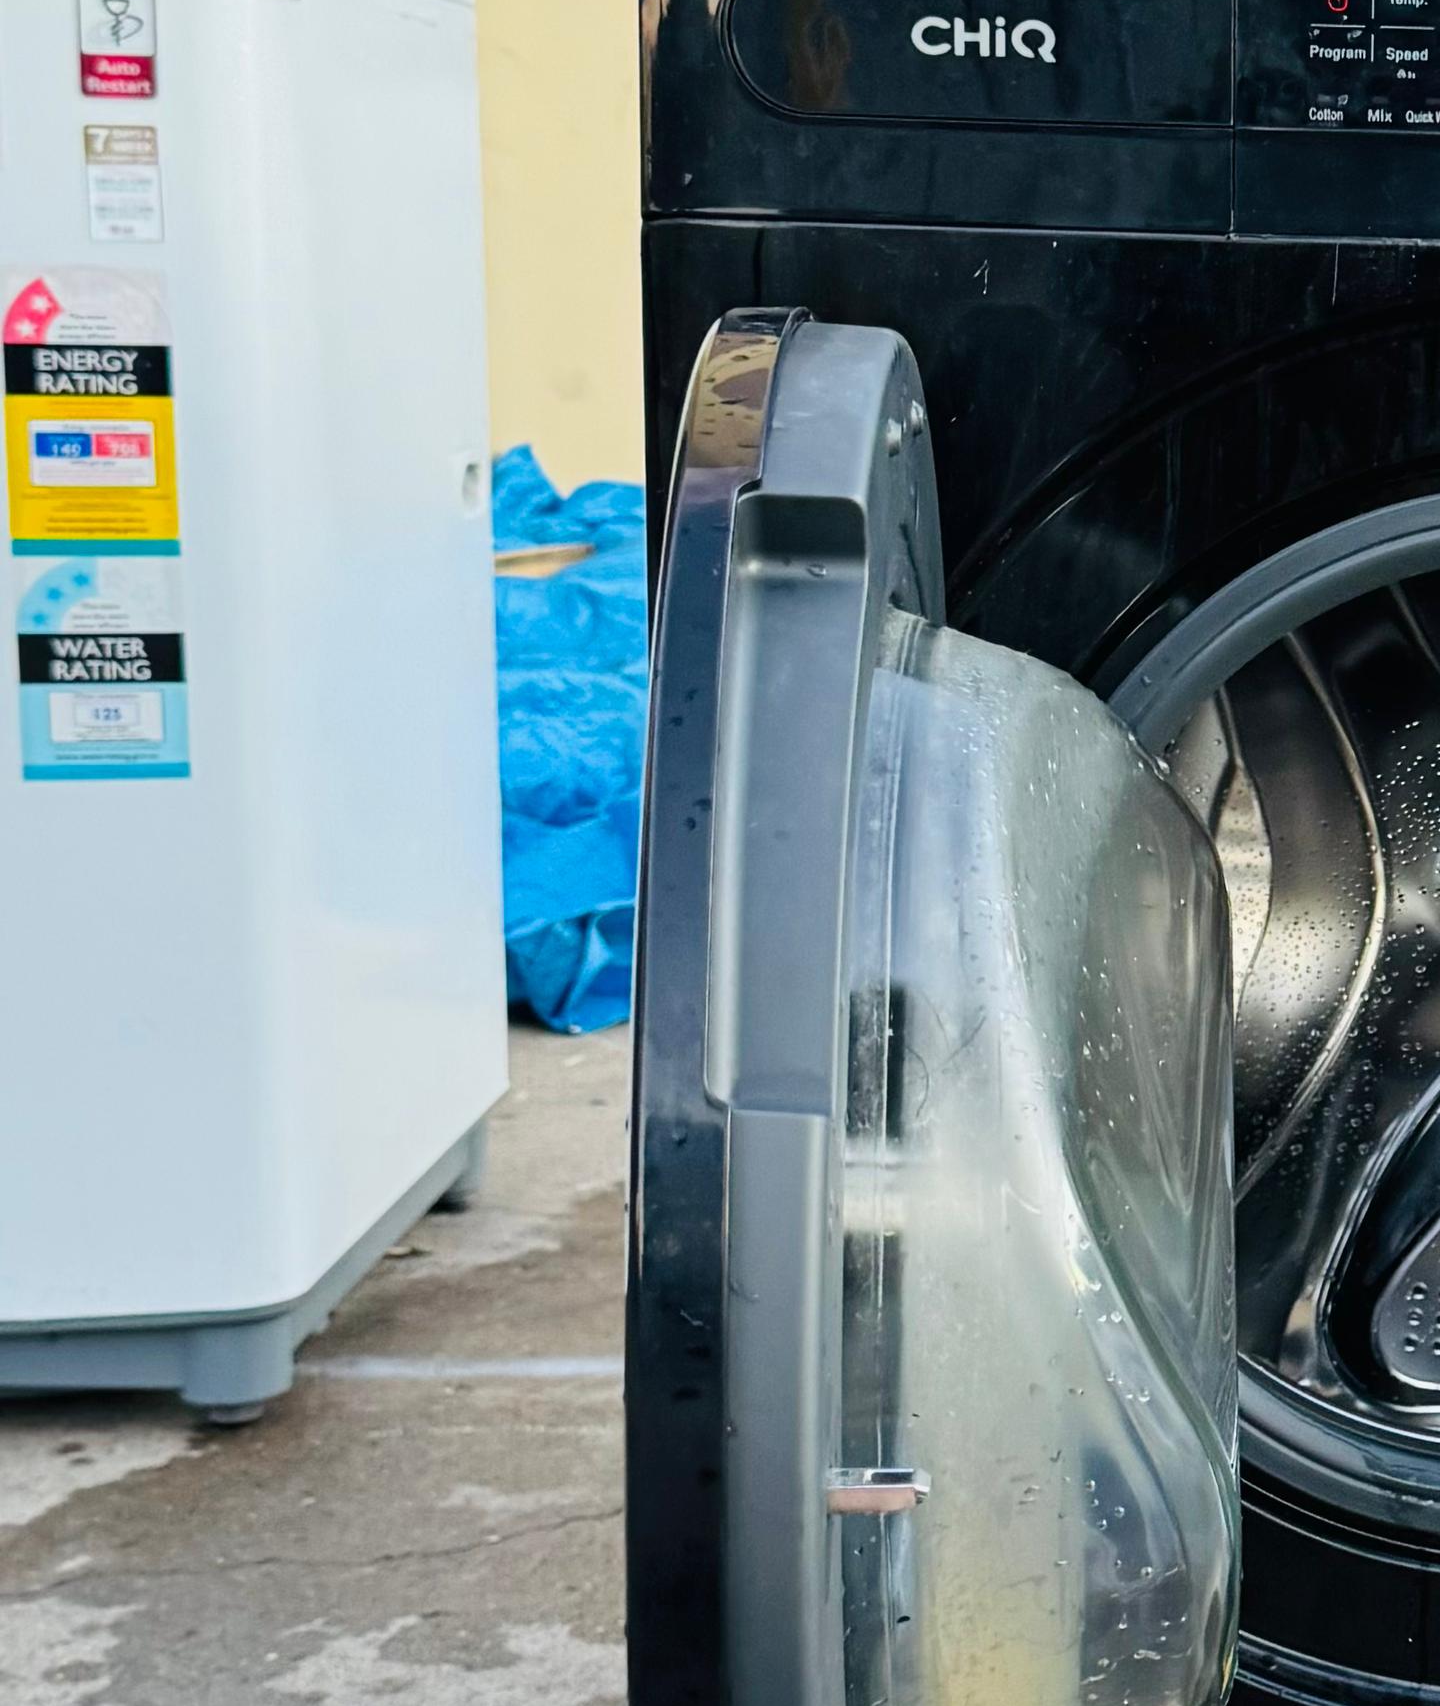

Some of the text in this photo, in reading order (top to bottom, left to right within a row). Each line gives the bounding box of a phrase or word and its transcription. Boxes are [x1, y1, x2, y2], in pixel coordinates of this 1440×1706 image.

[911, 16, 1057, 63] CHiQ
[1309, 45, 1366, 62] Program
[1386, 47, 1429, 62] Speed
[1309, 107, 1344, 122] Cotton
[1367, 109, 1392, 124] Mix
[1405, 110, 1435, 124] Quick
[35, 349, 138, 373] ENERGY
[38, 373, 138, 396] RATING
[51, 637, 148, 659] WATER
[51, 659, 152, 681] RATING
